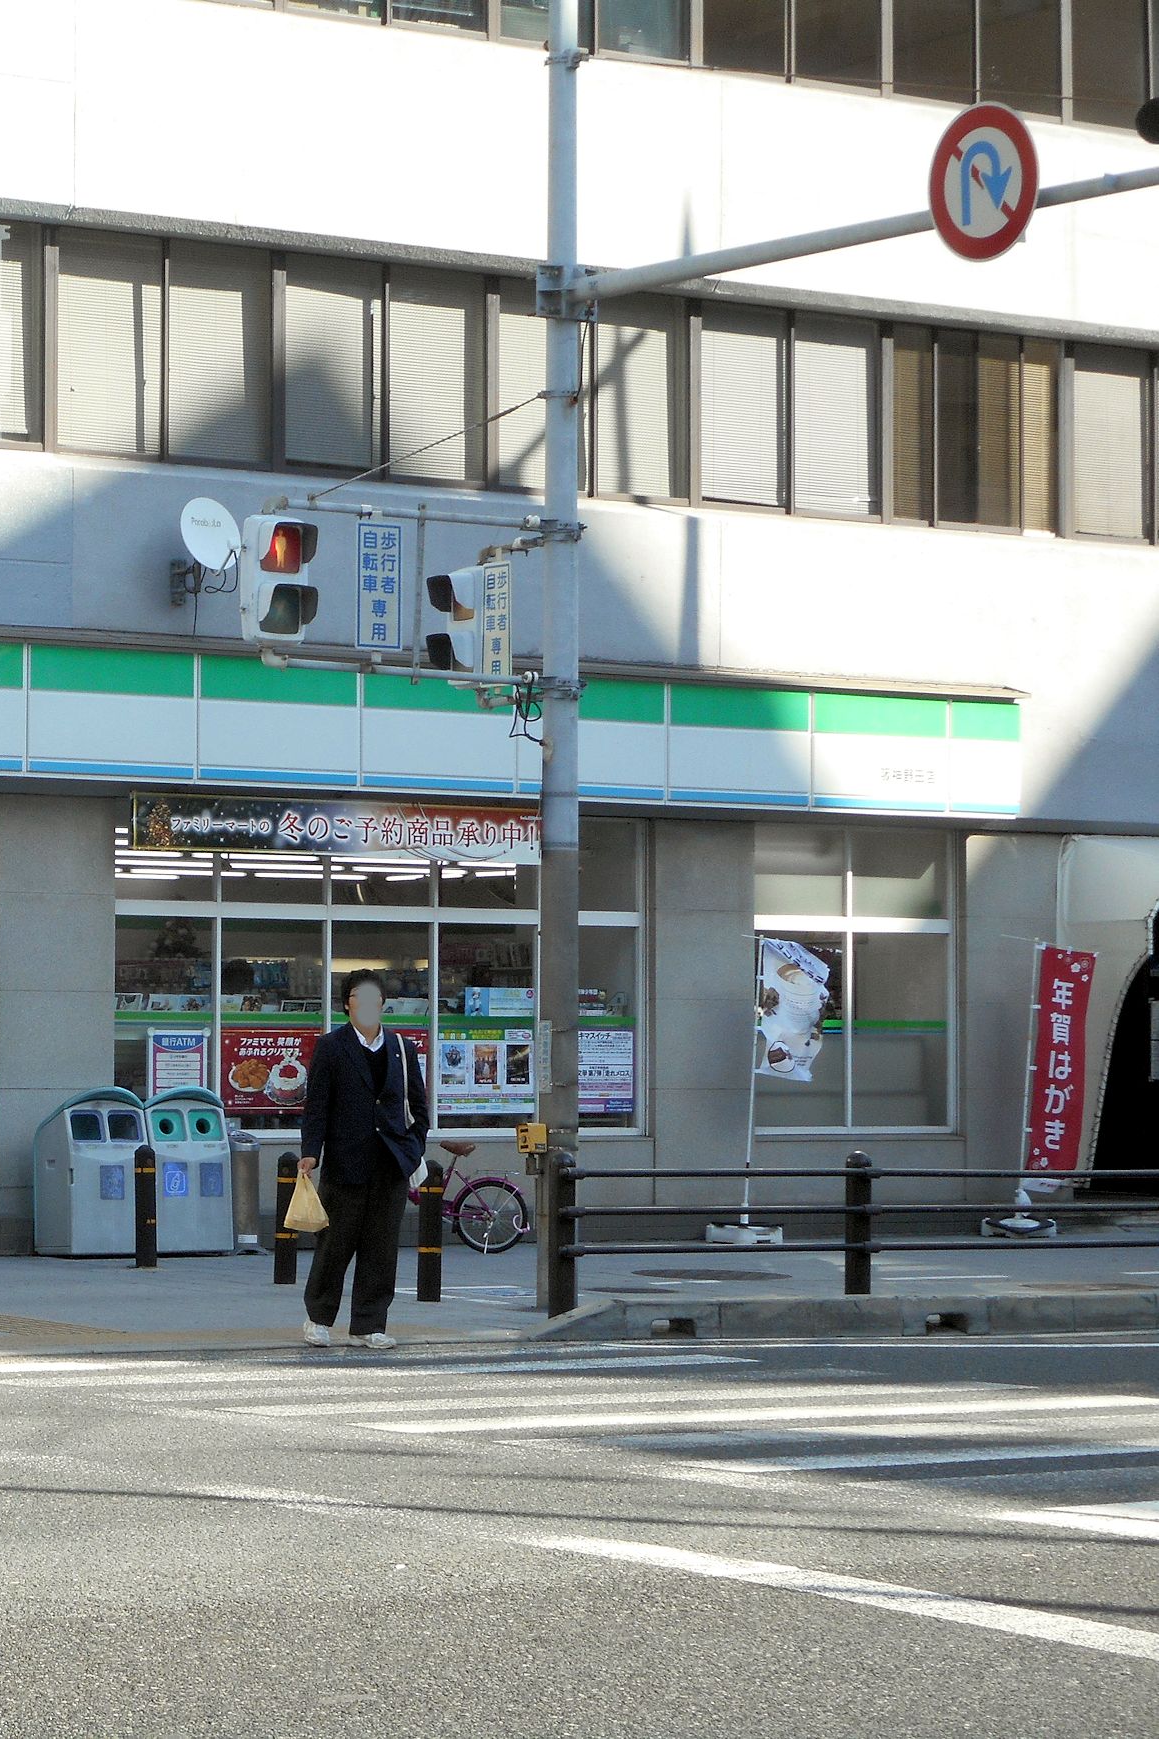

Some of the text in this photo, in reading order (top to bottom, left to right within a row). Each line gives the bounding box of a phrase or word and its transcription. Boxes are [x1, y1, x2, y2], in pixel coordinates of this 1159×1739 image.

[362, 531, 378, 593] 自転車
[379, 531, 396, 594] 歩行者
[371, 599, 387, 641] 専用
[485, 573, 496, 633] 自転車
[496, 571, 508, 632] 歩行者
[491, 637, 502, 674] 専用
[171, 816, 270, 835] ファミリーマートの
[161, 1037, 196, 1046] 銀行ATM
[239, 1047, 303, 1057] あふれるクリスマス。
[240, 1037, 302, 1047] ファミマで、笑顔が
[1044, 978, 1075, 1151] 年賀はがき
